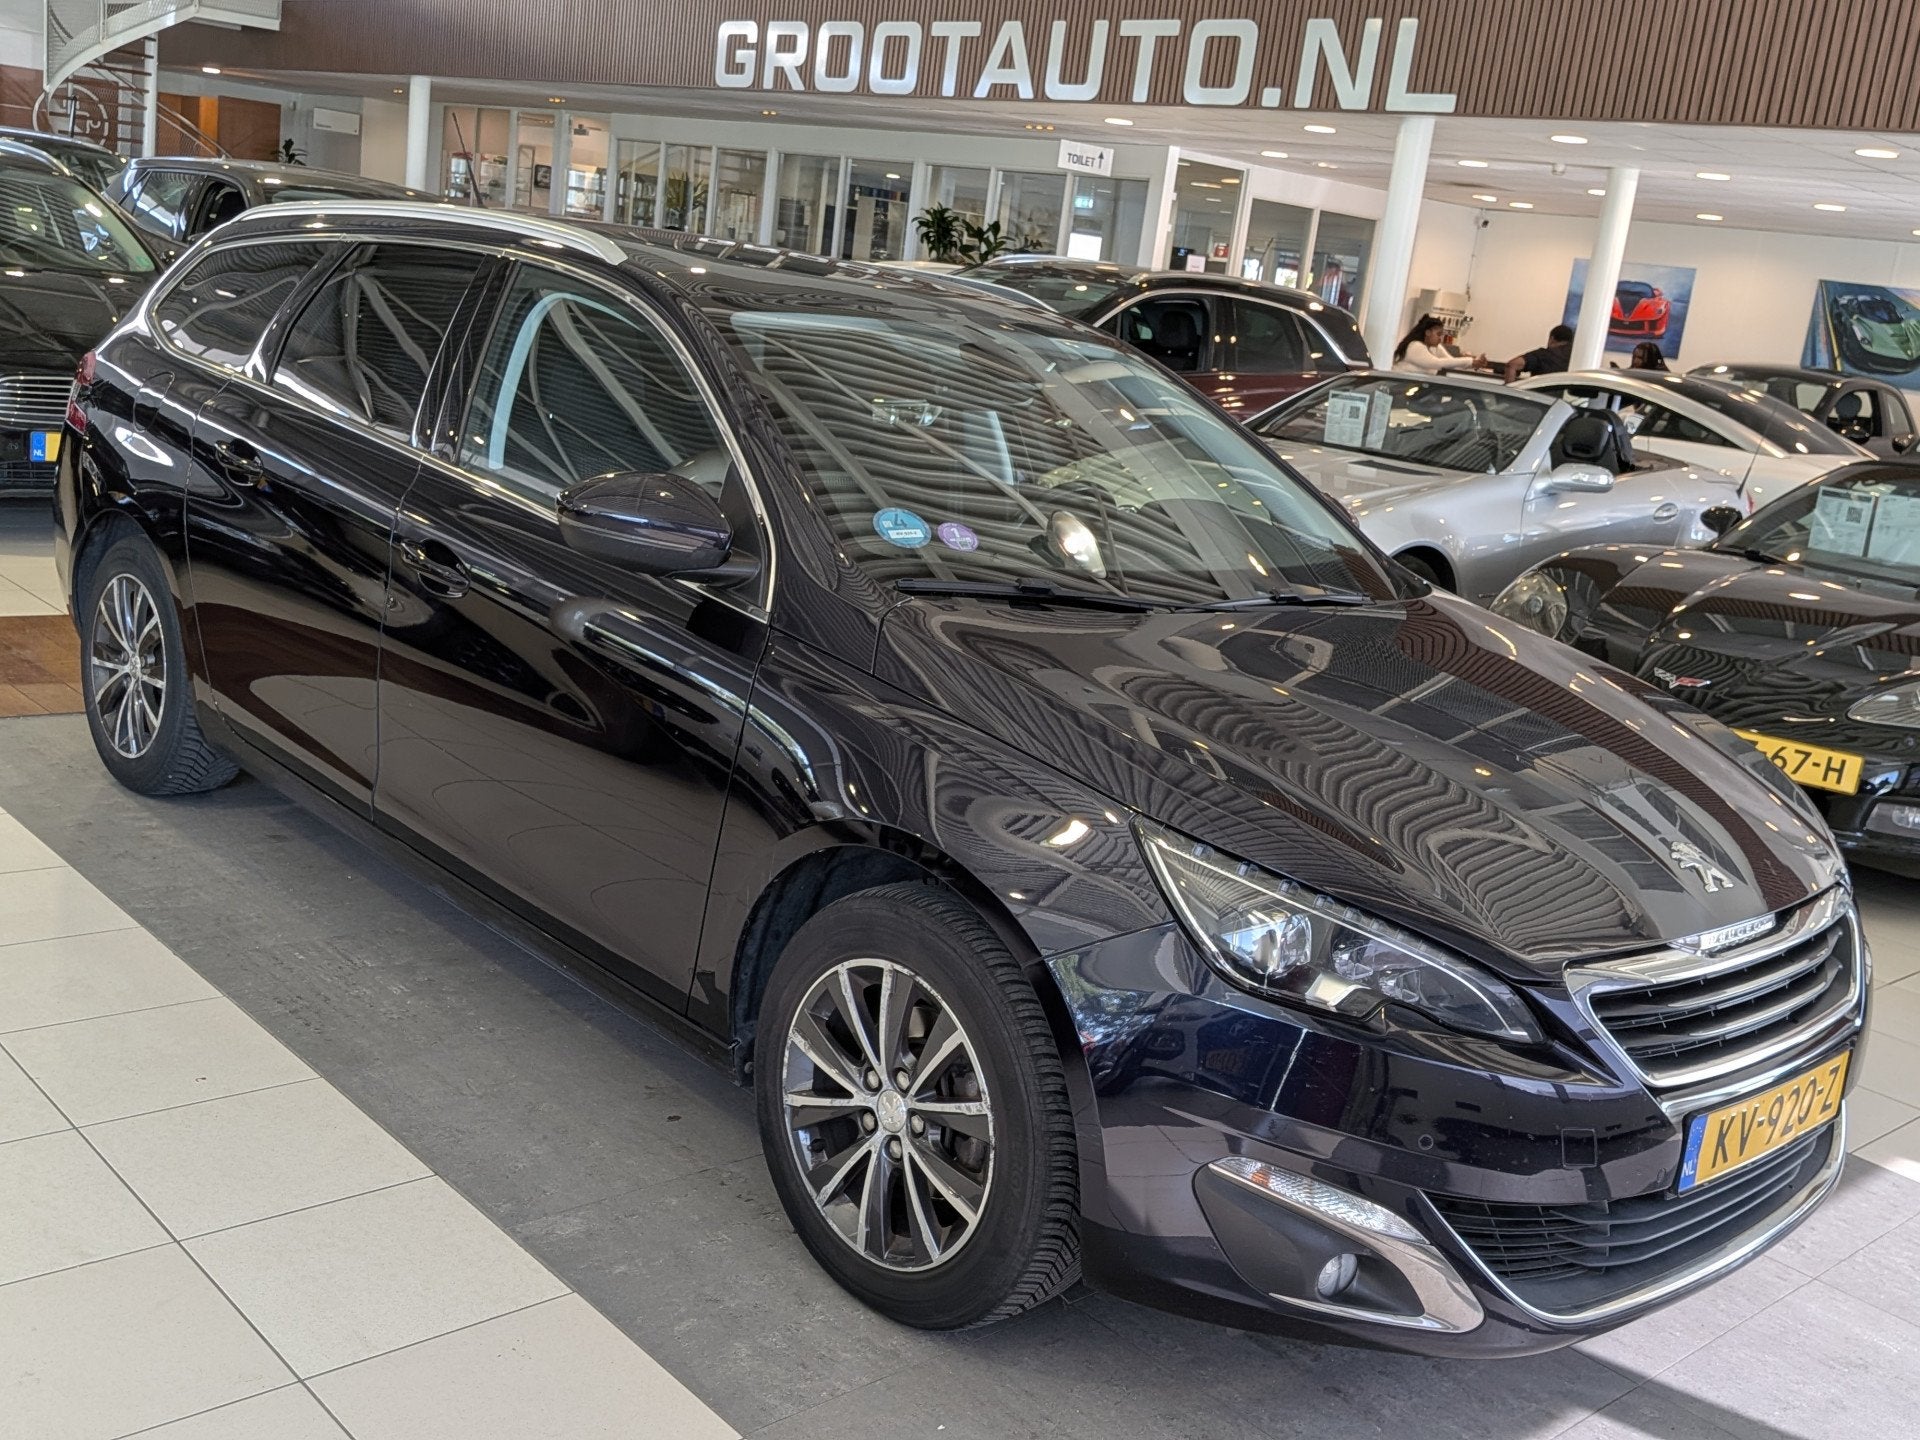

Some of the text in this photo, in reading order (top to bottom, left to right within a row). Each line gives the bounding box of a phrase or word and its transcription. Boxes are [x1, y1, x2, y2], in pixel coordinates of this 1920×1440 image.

[714, 18, 1458, 113] GROOTAUTO.NL
[1067, 152, 1096, 168] TOILET
[33, 449, 44, 457] NL
[1752, 741, 1847, 785] 67-H
[1711, 1063, 1841, 1169] KV-920-Z
[1682, 1160, 1695, 1178] NL
